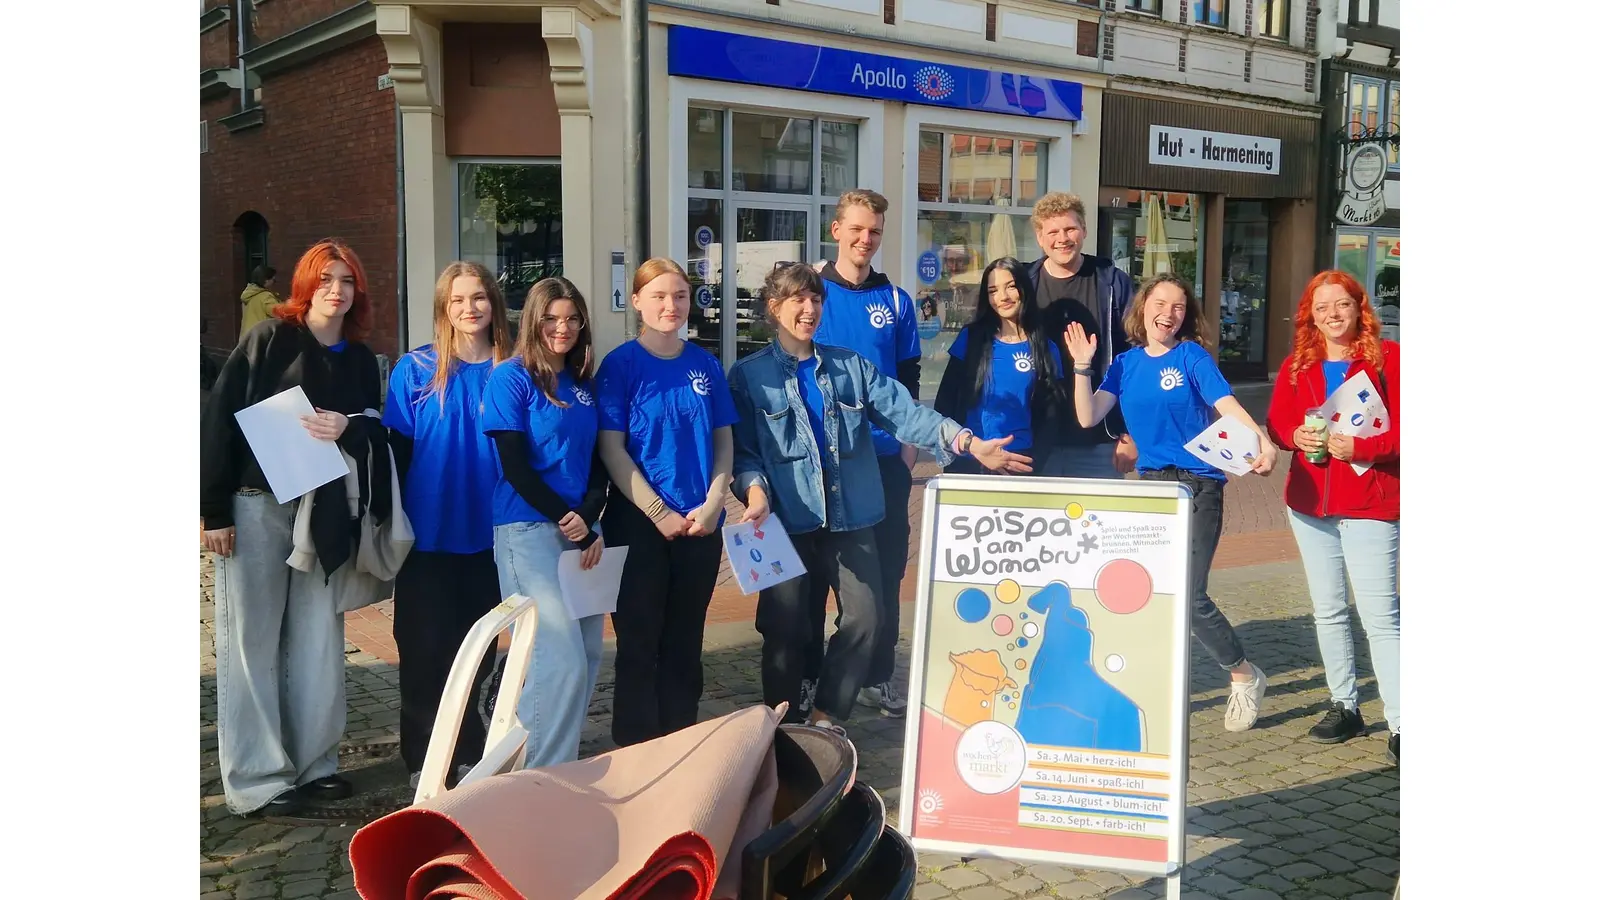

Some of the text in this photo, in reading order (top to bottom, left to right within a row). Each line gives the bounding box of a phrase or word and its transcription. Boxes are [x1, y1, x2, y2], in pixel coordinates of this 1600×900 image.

[851, 63, 906, 90] Apollo
[1158, 132, 1183, 157] Hut
[1202, 137, 1273, 170] Harmening
[1112, 197, 1120, 207] 17
[1343, 204, 1372, 223] Markt
[1101, 526, 1117, 534] Spiel
[1132, 525, 1149, 533] Spaß
[987, 540, 1023, 554] am
[1037, 751, 1136, 768] Sa. 3. Mai herz-ich!
[1036, 771, 1144, 789] Sa. 14. Juni spaß-ich!
[1035, 792, 1162, 812] Sa. 23. August blum-ich!
[1034, 812, 1146, 832] Sa. 20. Sept. farb-ich!
